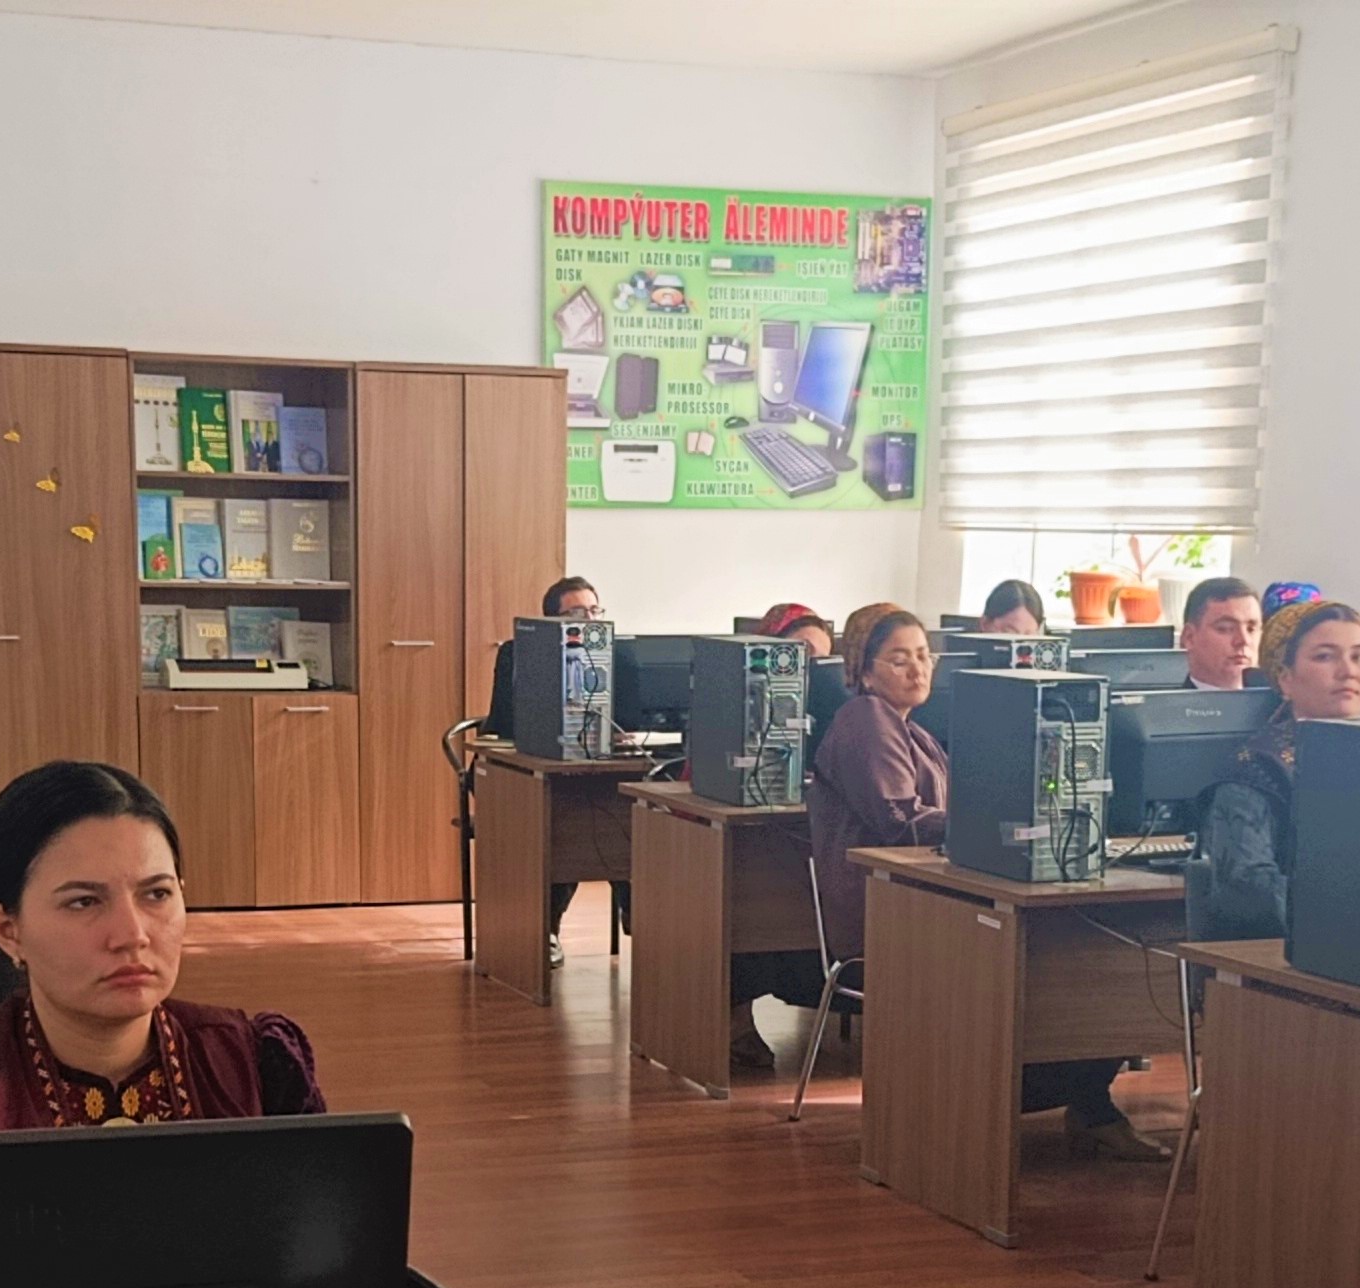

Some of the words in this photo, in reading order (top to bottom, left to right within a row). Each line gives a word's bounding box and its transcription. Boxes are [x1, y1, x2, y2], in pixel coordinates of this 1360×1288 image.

[553, 193, 710, 242] KOMPÝUTER
[725, 196, 848, 247] ÄLEMINDE
[556, 249, 583, 262] GATY
[587, 251, 629, 263] MAGNIT
[640, 252, 672, 265] LAZER
[675, 254, 701, 267] DISK
[556, 268, 582, 281] DISK
[646, 317, 674, 330] LAZER
[677, 318, 703, 331] DISKI
[667, 382, 703, 396] MIKRO
[871, 386, 919, 399] MONITOR
[667, 401, 730, 415] PROSESSOR
[882, 414, 902, 427] UPS
[613, 424, 633, 438] SES
[568, 446, 593, 459] ANER
[568, 486, 597, 500] NTER
[686, 483, 754, 496] KLAWIATURA
